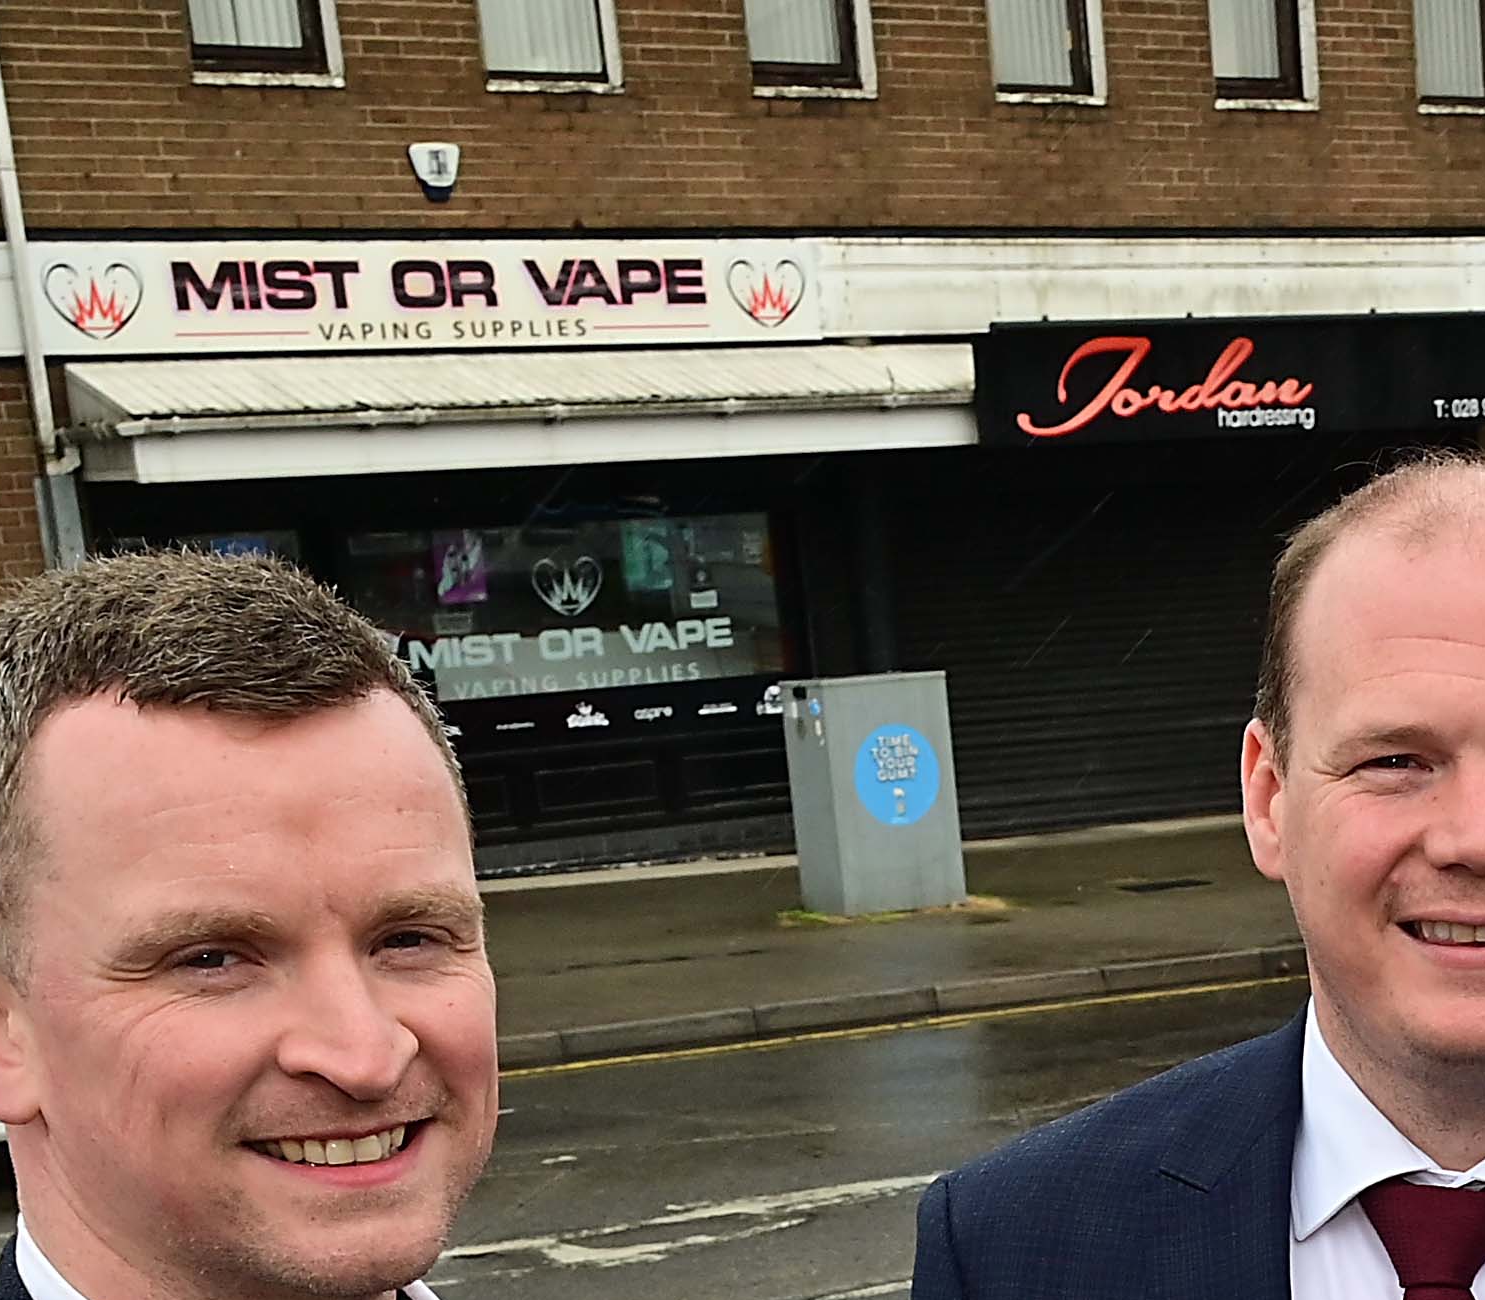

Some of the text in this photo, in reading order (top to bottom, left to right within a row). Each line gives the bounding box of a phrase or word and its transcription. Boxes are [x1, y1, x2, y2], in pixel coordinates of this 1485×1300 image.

[170, 258, 708, 312] MIST OR VAPE
[318, 318, 588, 342] VAPING SUPPLIES
[1016, 336, 1314, 437] Jordan
[1217, 406, 1316, 430] hairdressing
[1433, 399, 1449, 418] T:
[1451, 398, 1480, 418] 028
[407, 616, 734, 672] MIST OR VAPE
[453, 661, 701, 701] VAPING SUPPLIES
[877, 733, 911, 747] TIME
[871, 747, 890, 759] TO
[875, 755, 917, 769] YOUR
